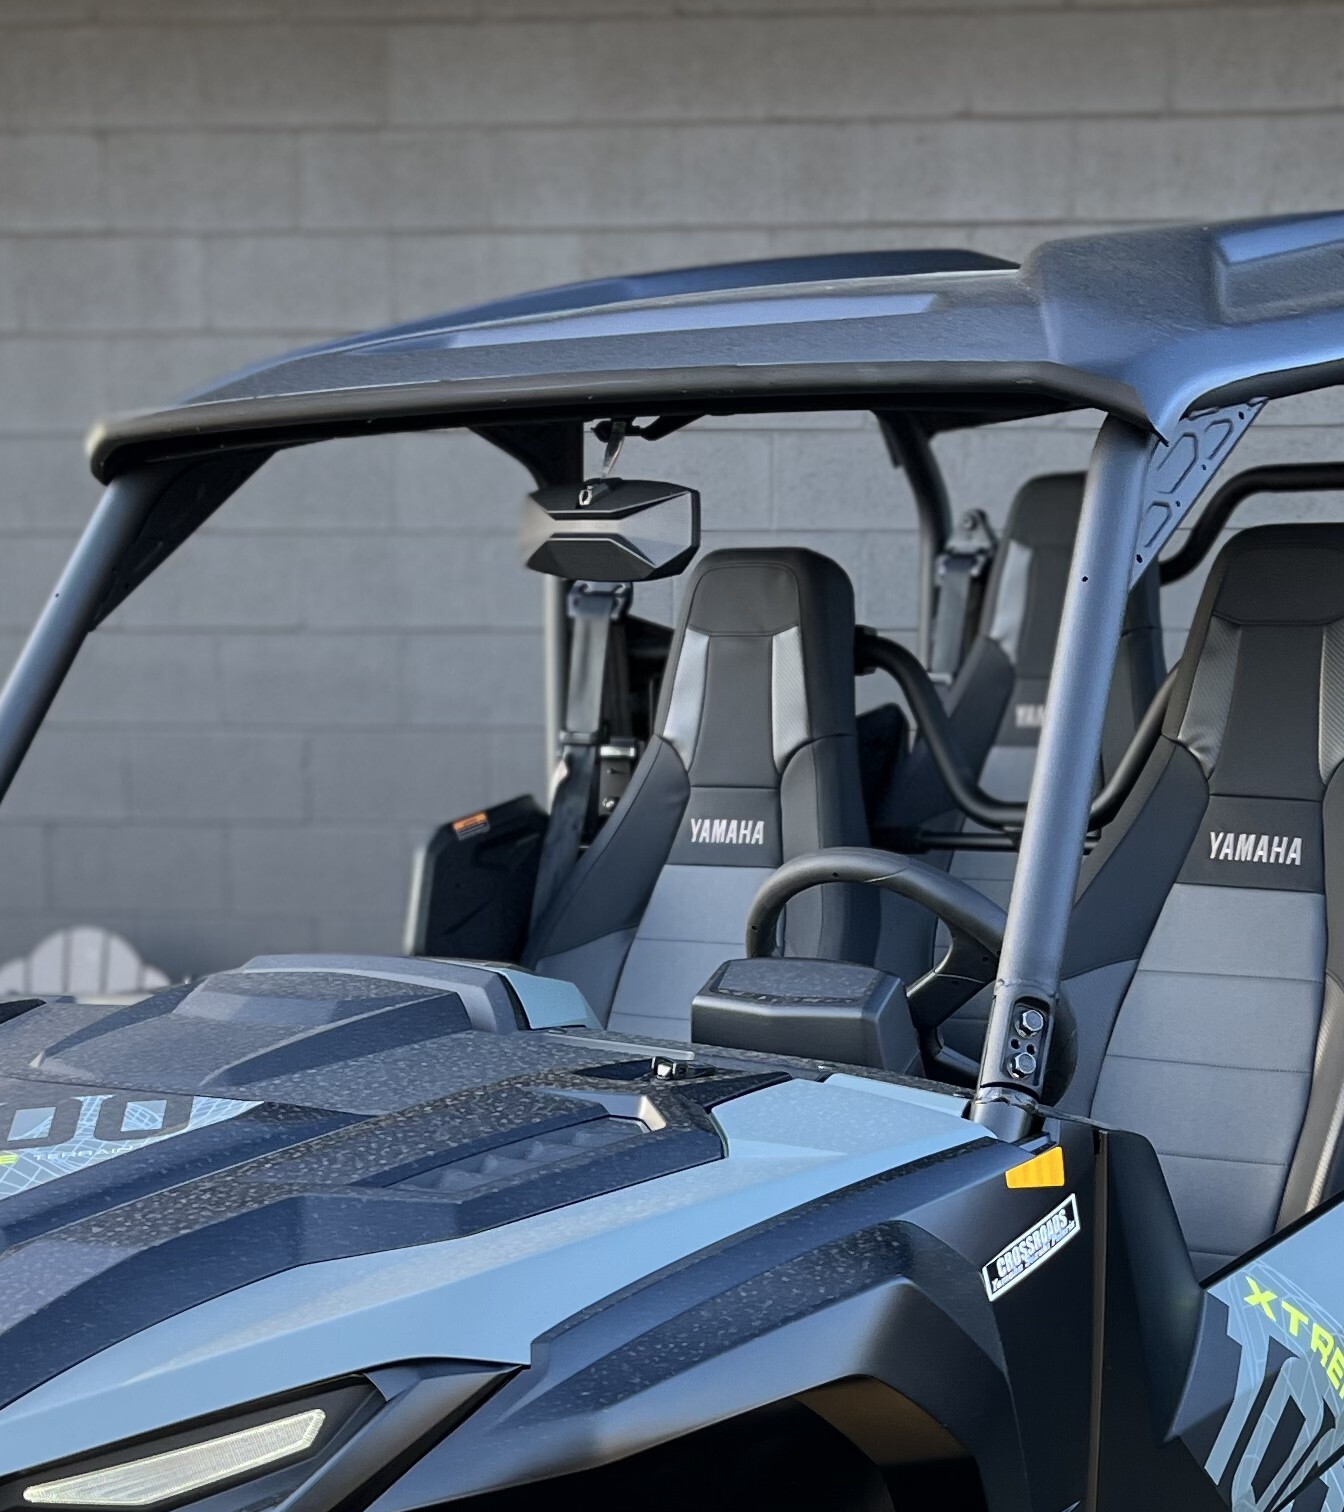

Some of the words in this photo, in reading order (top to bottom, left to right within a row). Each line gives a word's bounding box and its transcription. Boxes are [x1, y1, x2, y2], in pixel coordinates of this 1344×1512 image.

[690, 818, 765, 845] YAMAHA
[1209, 831, 1302, 866] YAMAHA
[34, 1144, 134, 1161] TERRAIN
[996, 1207, 1069, 1279] CROSSROADS
